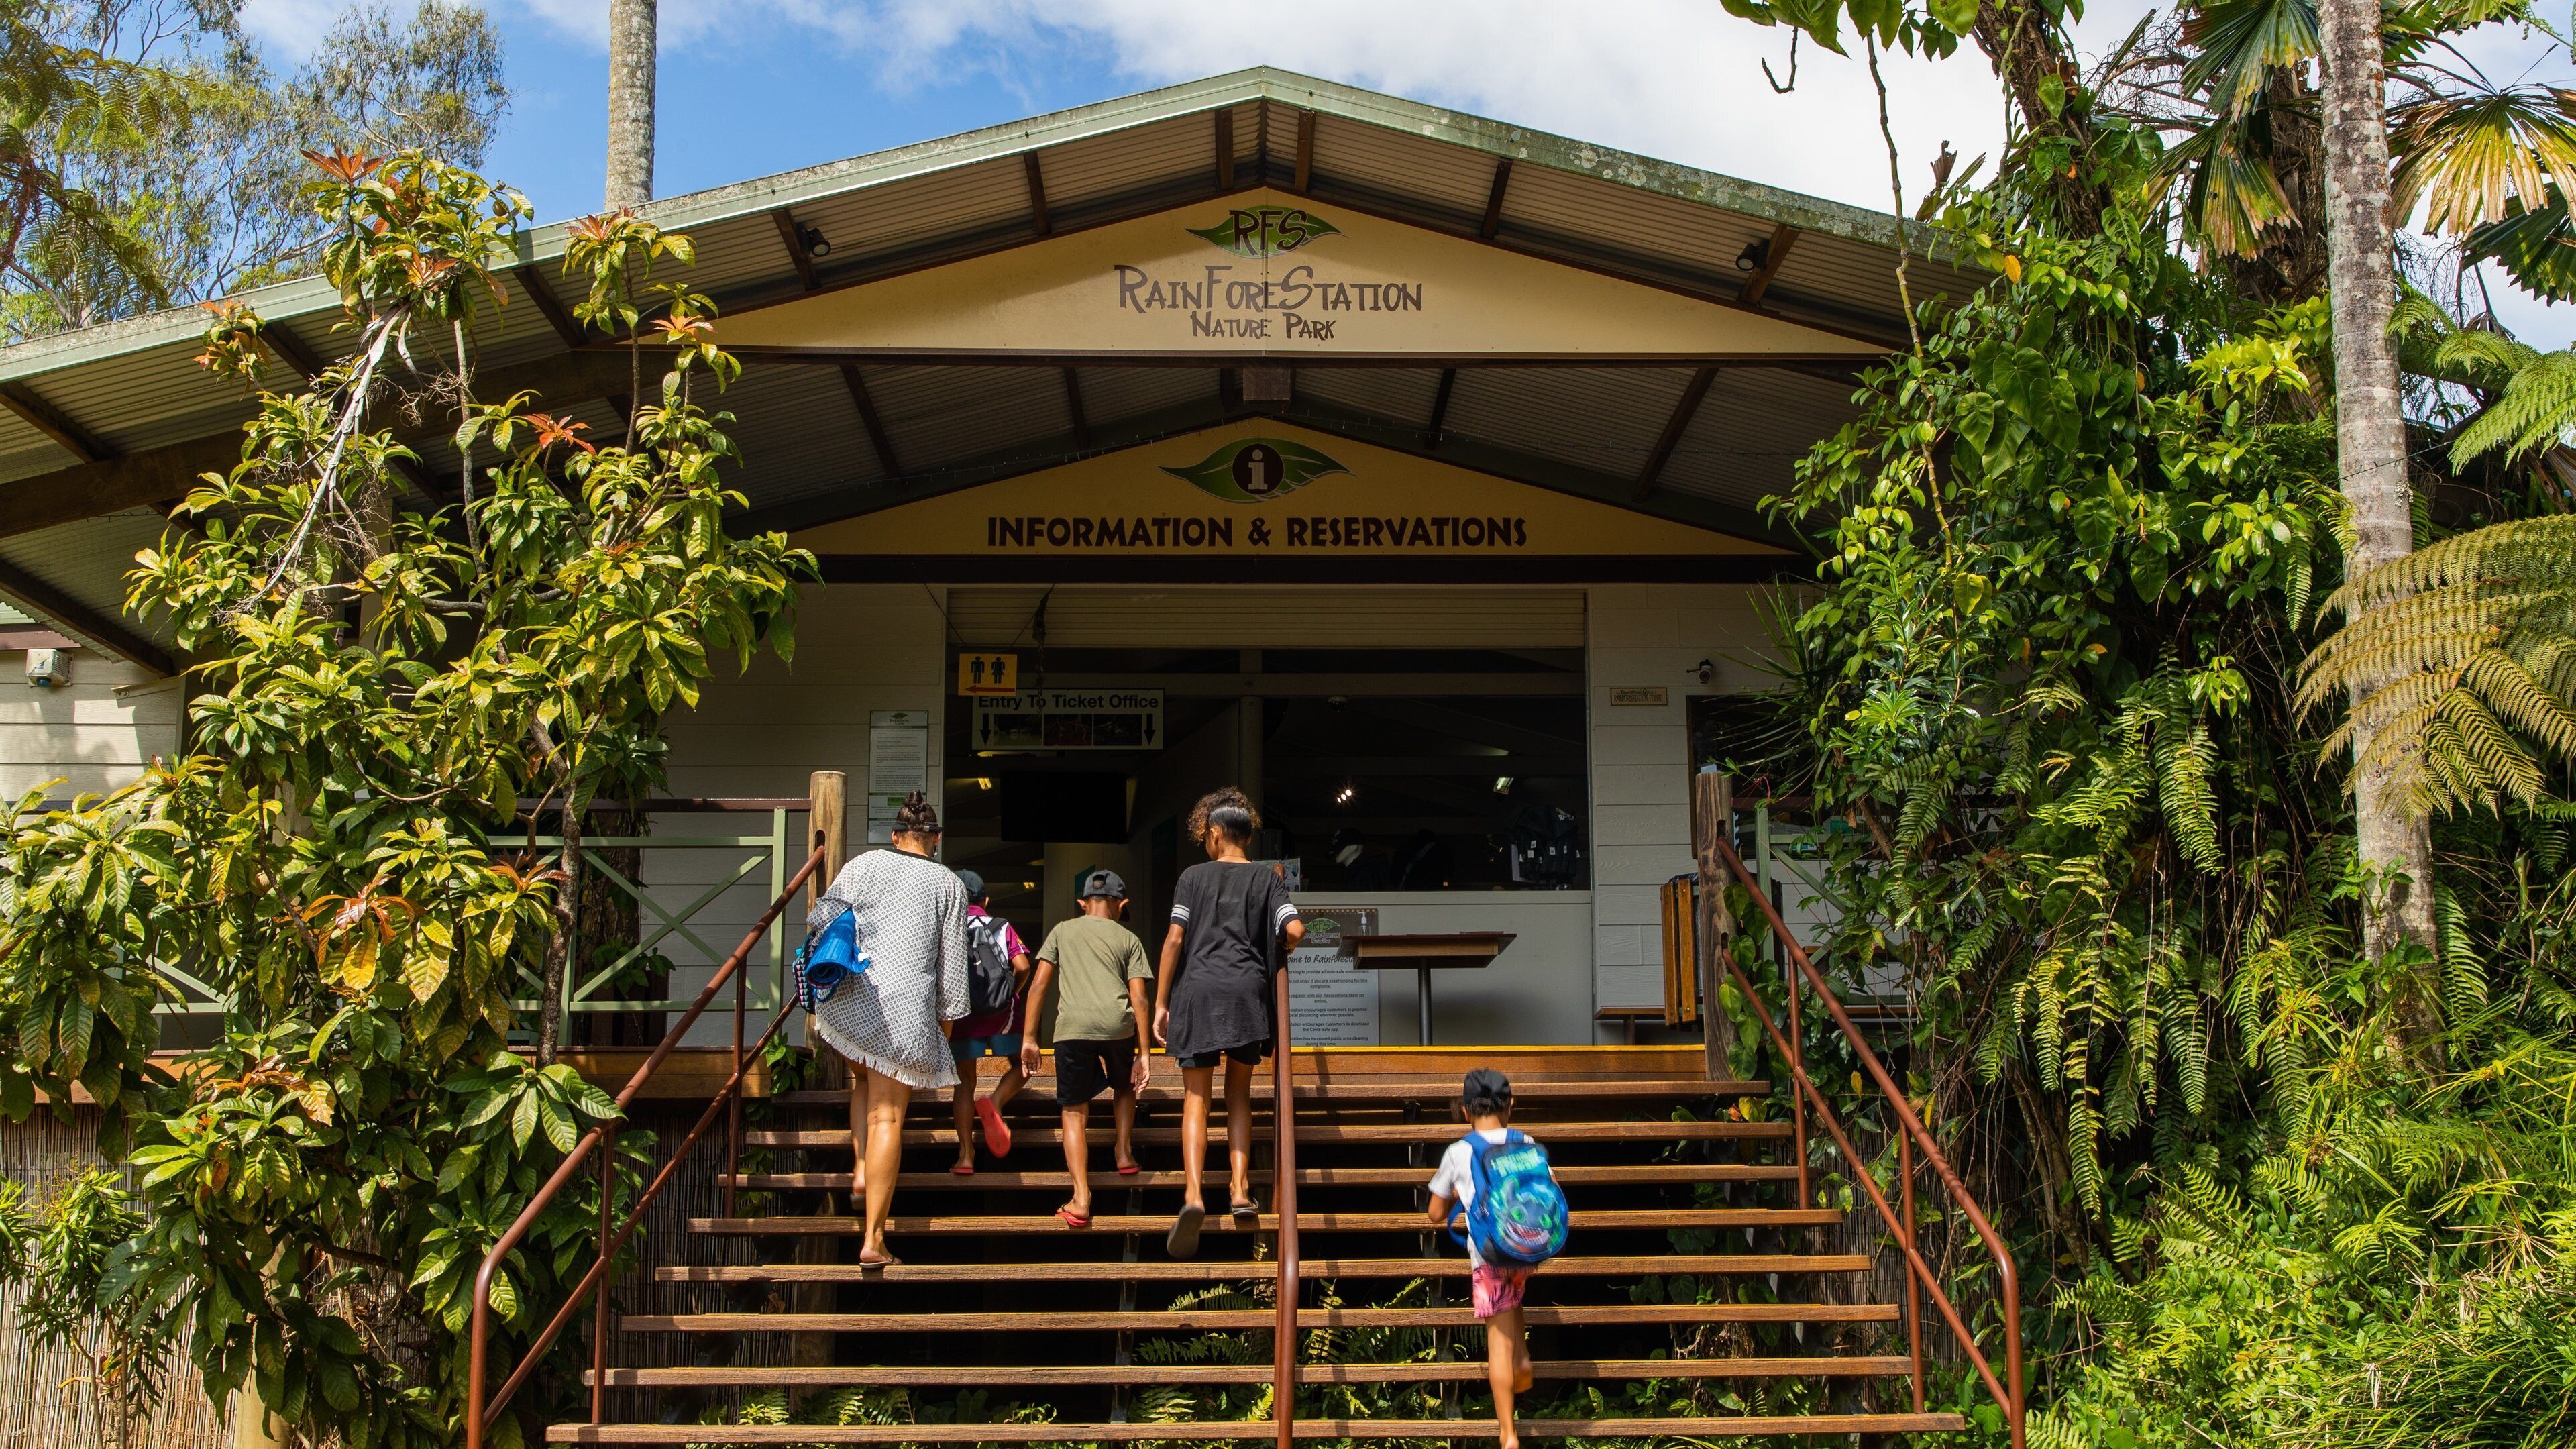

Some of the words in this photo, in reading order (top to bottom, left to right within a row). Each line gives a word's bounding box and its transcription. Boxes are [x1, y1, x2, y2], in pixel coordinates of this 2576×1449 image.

[1228, 209, 1309, 256] RFS
[987, 516, 1234, 547] INFORMATION
[1247, 516, 1272, 547] &
[1286, 516, 1528, 548] RESERVATIONS
[977, 694, 1023, 712] Entry
[1026, 694, 1048, 709] To
[1051, 694, 1105, 709] Ticket
[1108, 694, 1159, 709] Office
[1305, 954, 1311, 963] to
